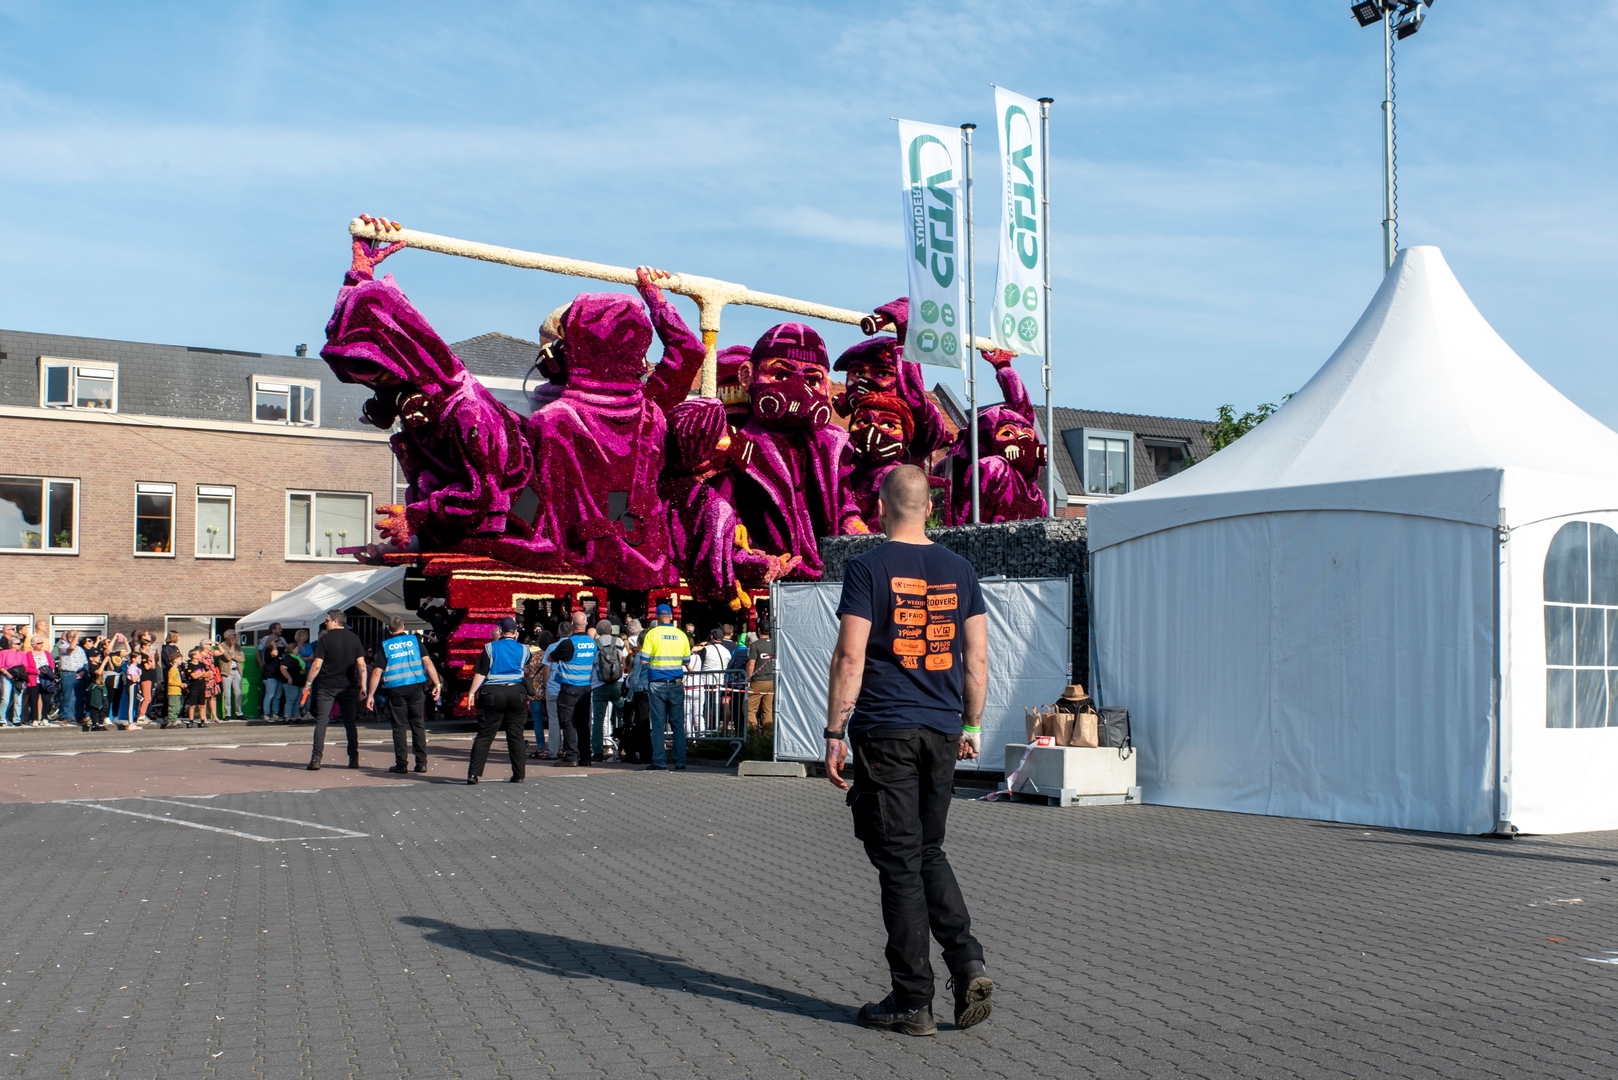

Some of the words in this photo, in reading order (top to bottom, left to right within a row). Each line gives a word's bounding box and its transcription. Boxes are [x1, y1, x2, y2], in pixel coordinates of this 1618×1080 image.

[927, 597, 956, 607] ROOVERS
[389, 641, 413, 650] corso
[577, 642, 595, 650] corso
[391, 650, 415, 658] zundert
